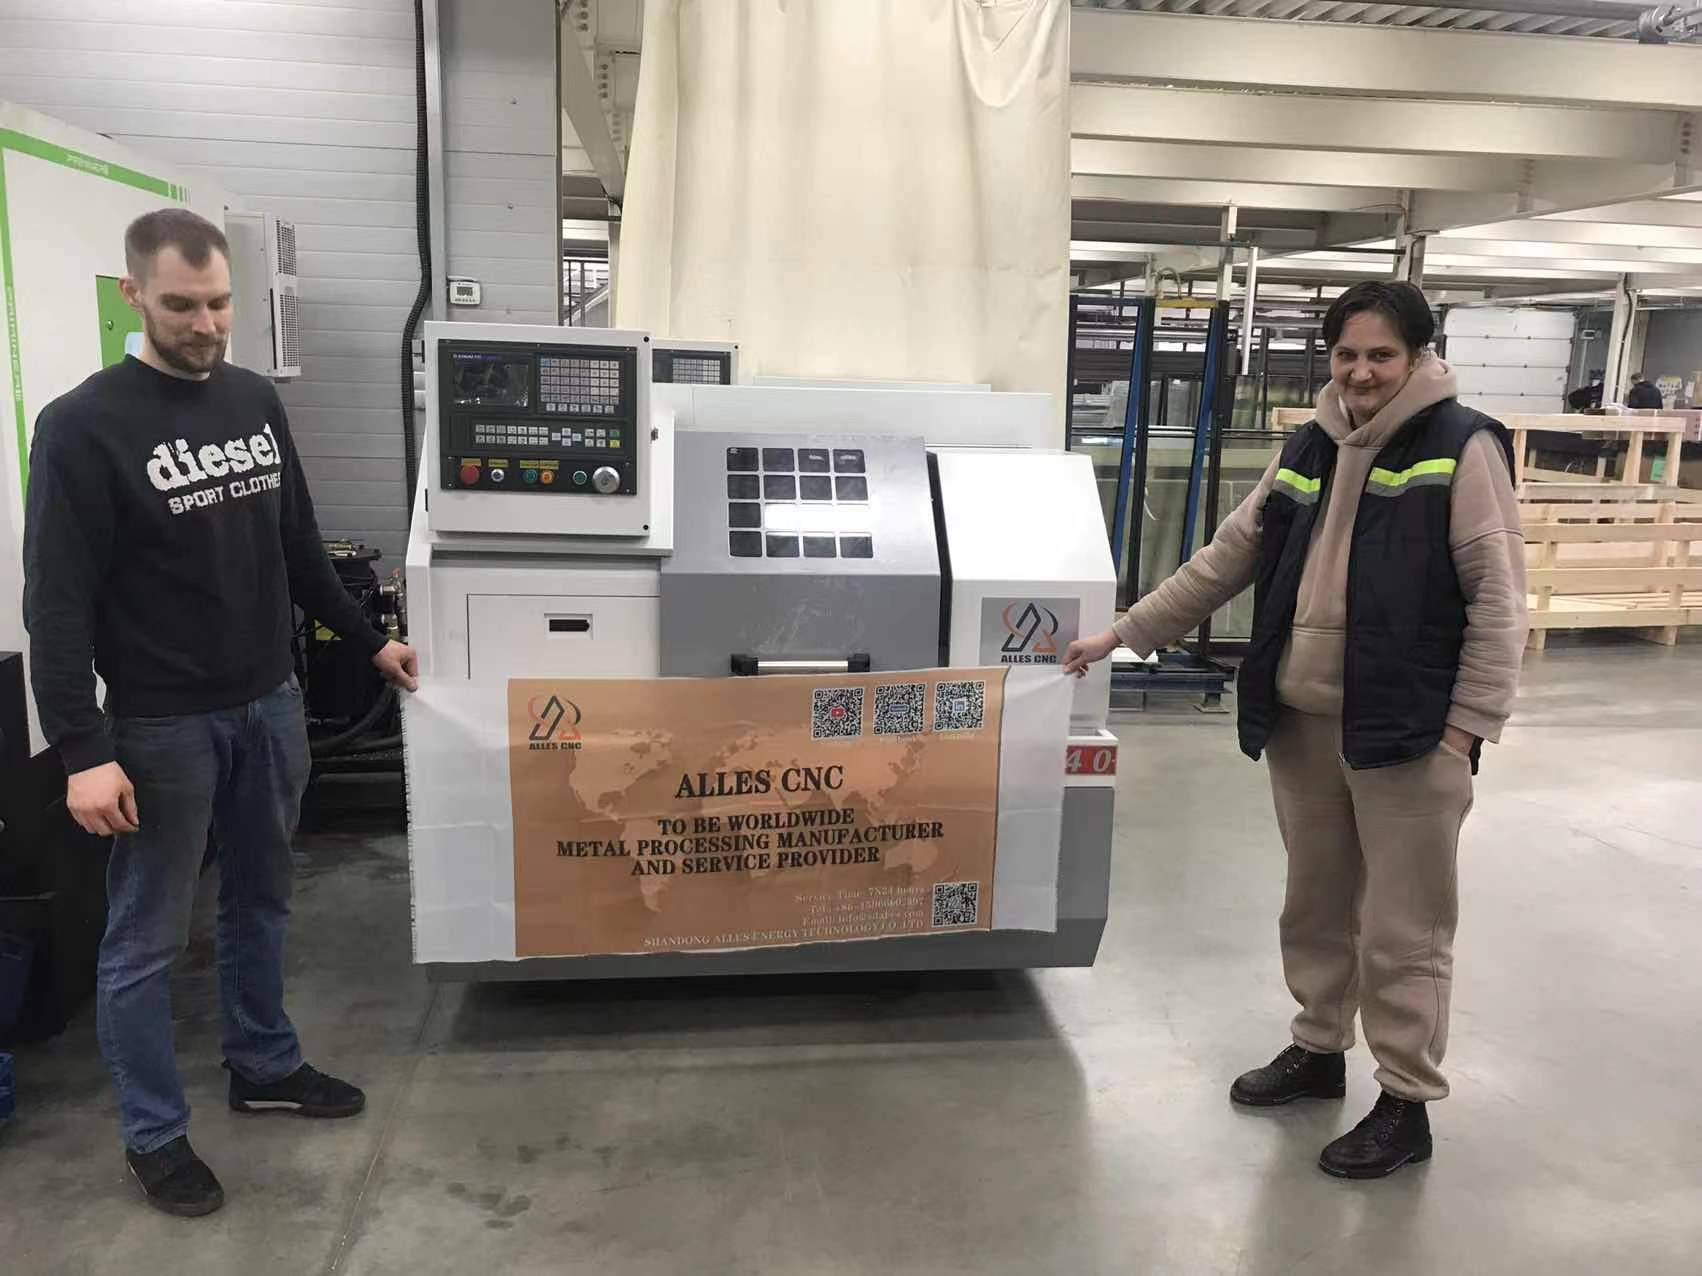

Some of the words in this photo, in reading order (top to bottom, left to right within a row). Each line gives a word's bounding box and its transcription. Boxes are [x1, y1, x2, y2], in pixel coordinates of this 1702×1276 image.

[147, 423, 282, 491] diesel
[168, 486, 224, 515] SPORT
[1001, 655, 1031, 664] ALLES
[1034, 655, 1057, 664] CNC
[529, 742, 558, 750] ALLES
[560, 742, 582, 750] CNC
[674, 769, 771, 798] ALLES
[781, 765, 844, 793] CNC
[658, 818, 687, 836] TO
[694, 816, 721, 833] BE
[728, 808, 855, 831] WORLDWIDE
[557, 840, 632, 858] METAL
[637, 833, 769, 856] PROCESSING
[777, 822, 944, 849] MANUFACTURER
[631, 859, 676, 876] AND
[682, 854, 771, 874] SERVICE
[776, 847, 880, 869] PROVIDER
[644, 935, 710, 947] SHANDONG
[714, 933, 749, 945] ALLES
[752, 928, 800, 941] ENERGY
[802, 923, 880, 937] TECHNOLOGY
